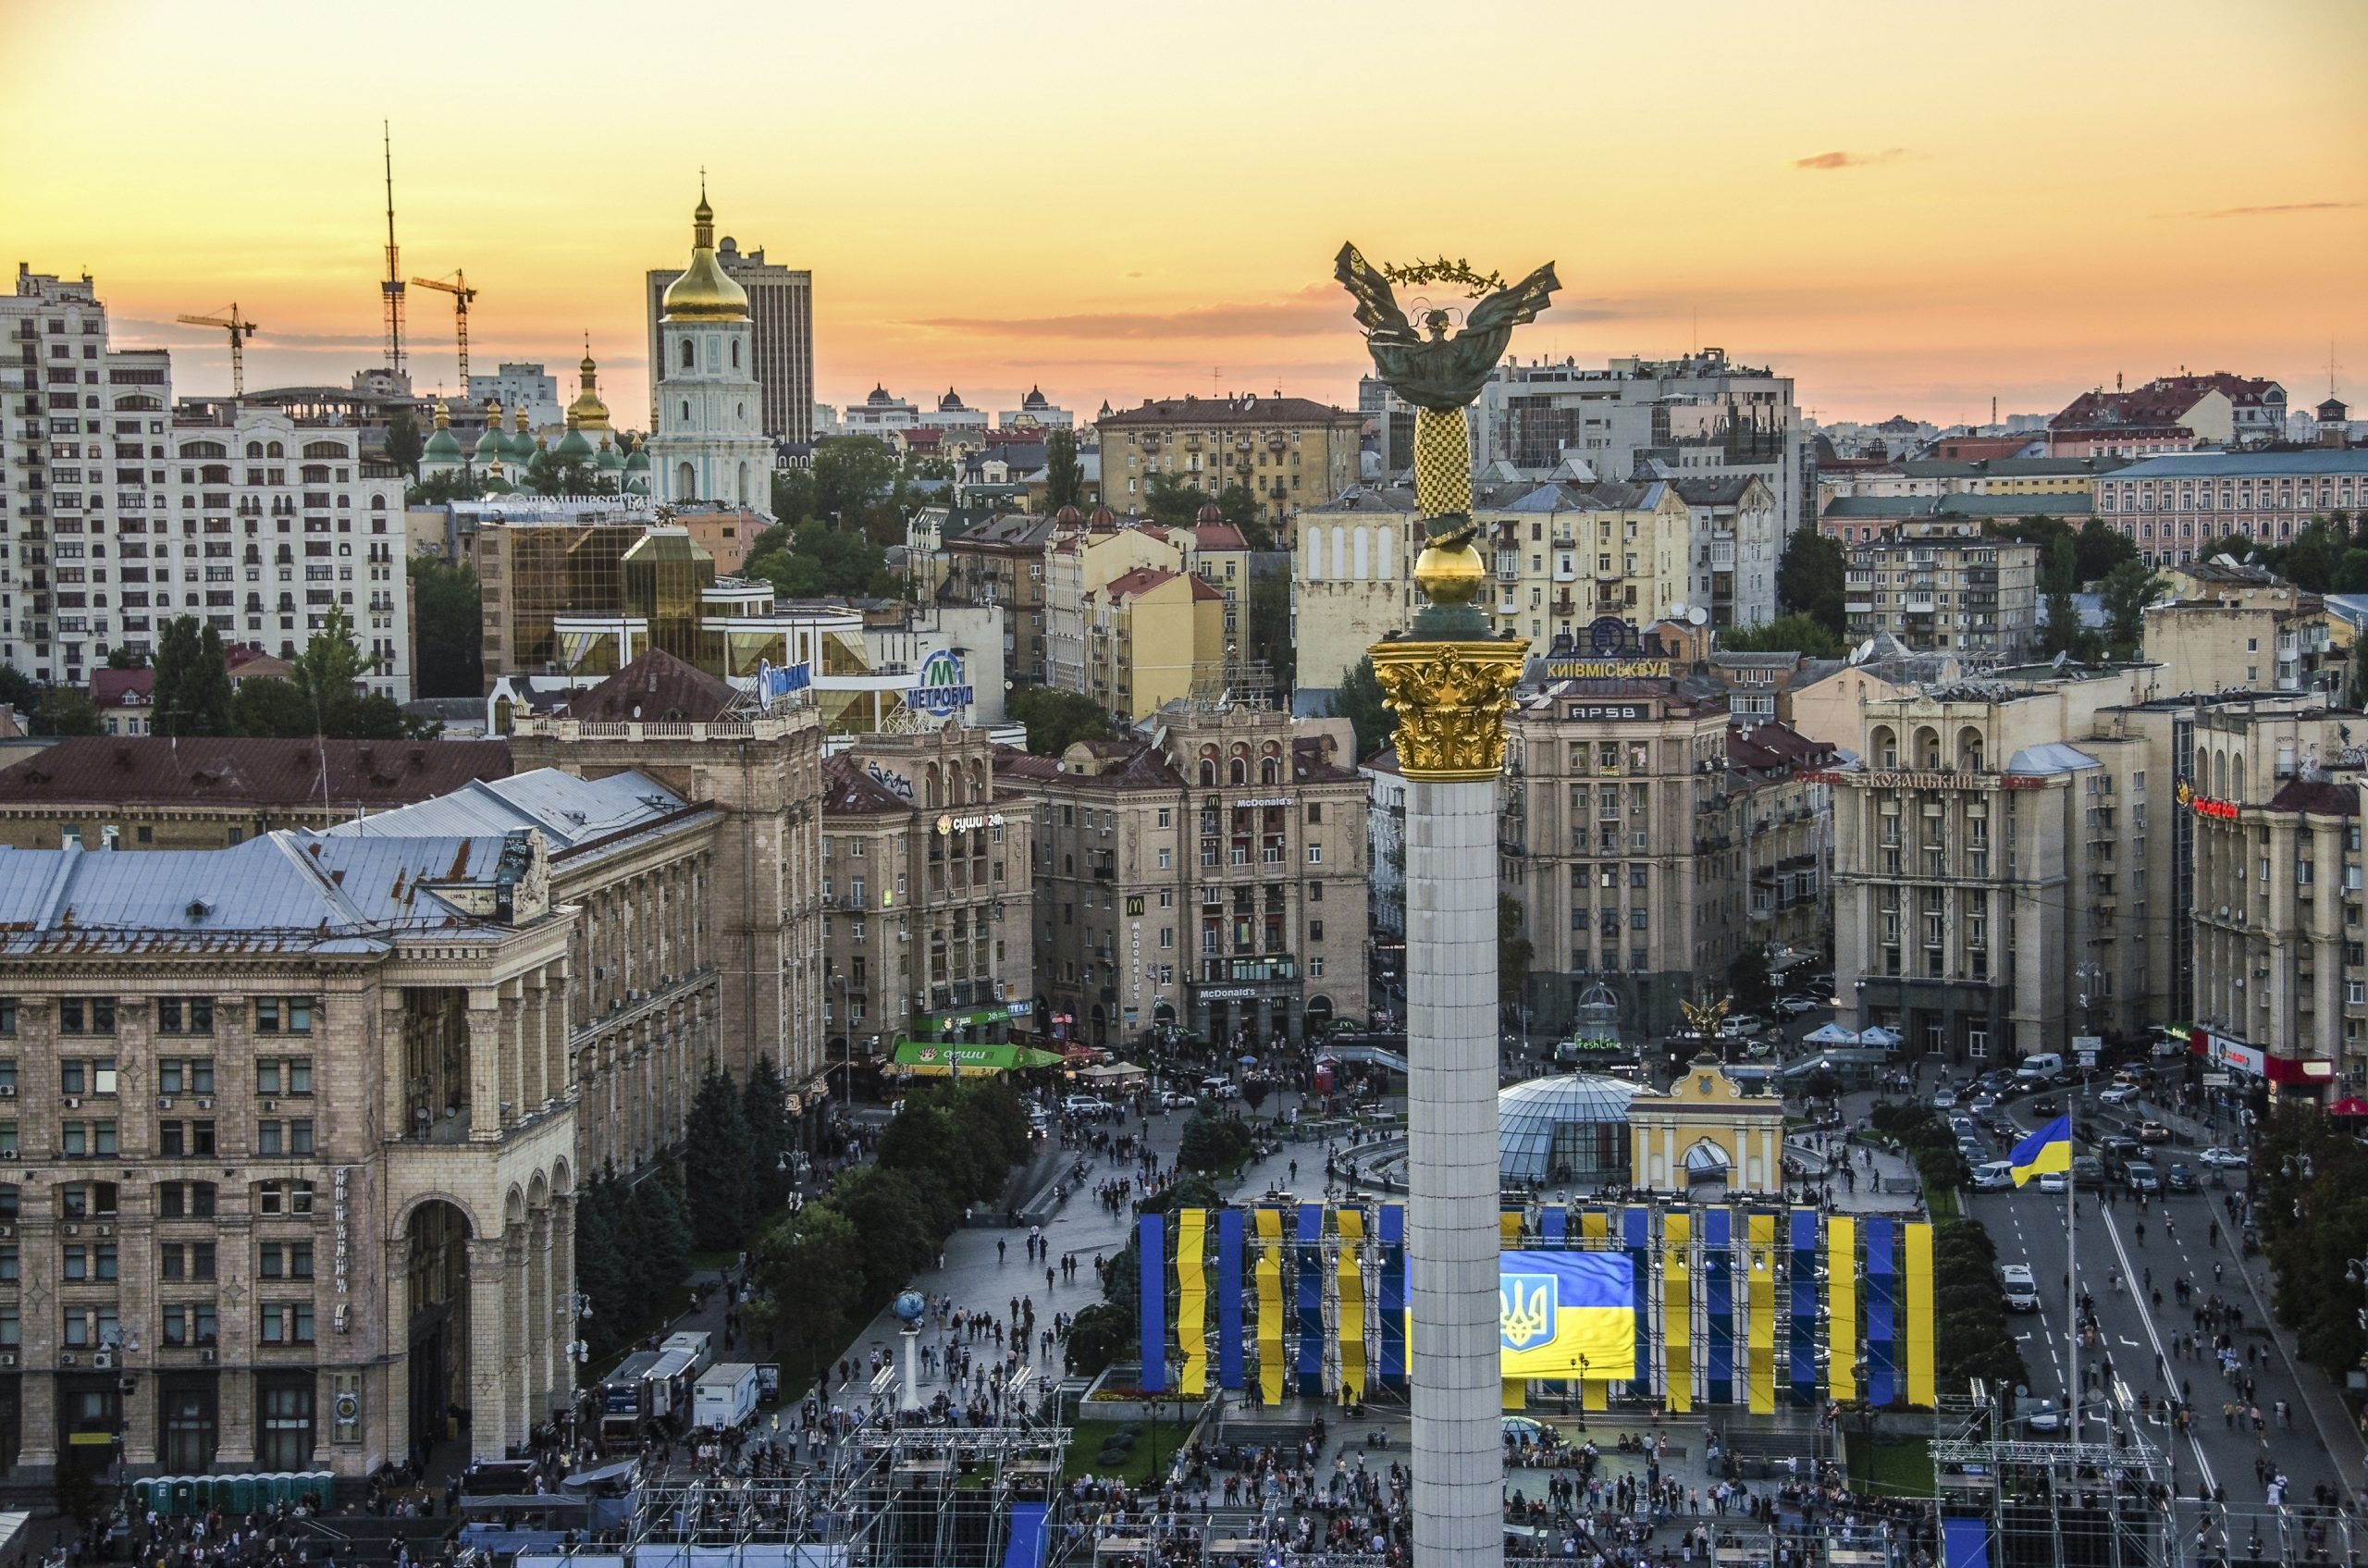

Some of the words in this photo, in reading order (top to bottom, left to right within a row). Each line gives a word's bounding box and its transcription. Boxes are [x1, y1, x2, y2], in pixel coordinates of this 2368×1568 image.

[1547, 660, 1670, 678] КИЇВМІСЬКБУД
[907, 685, 974, 710] МЕТРОБУД
[1870, 771, 1973, 791] КОЗАЦЬКИЙ
[1237, 797, 1292, 808] McDonald's
[1200, 988, 1255, 998] McDonald's
